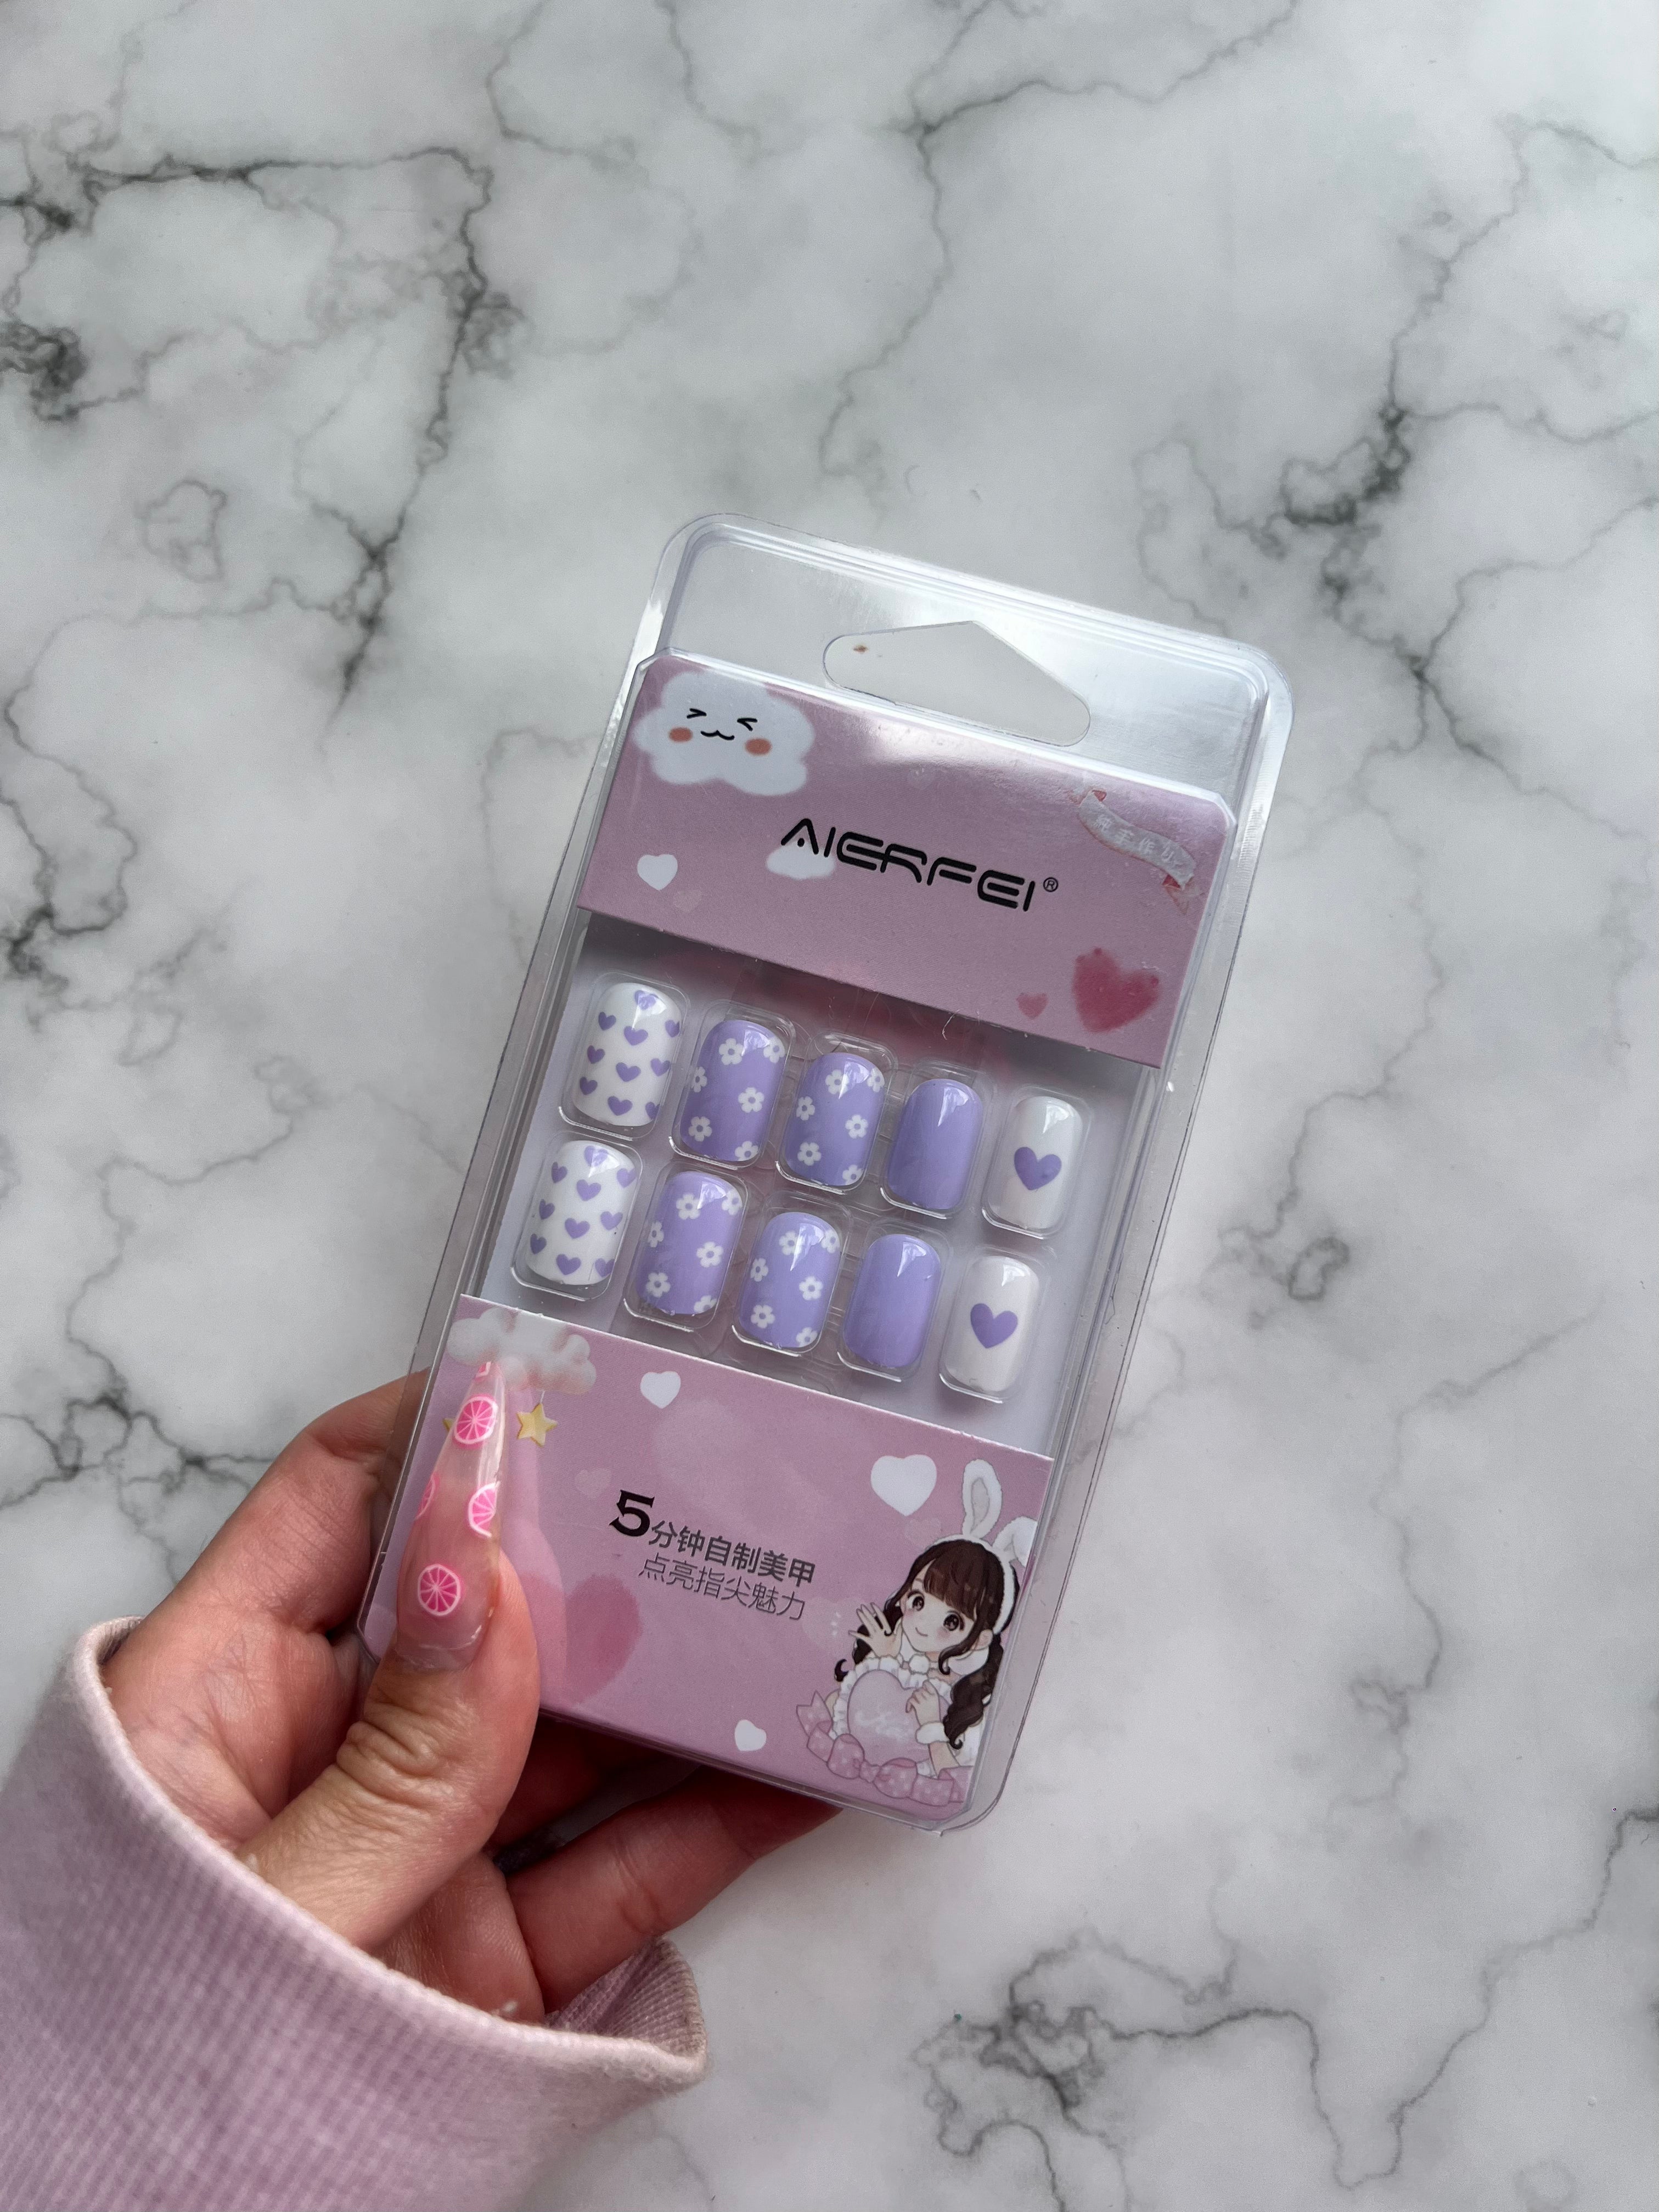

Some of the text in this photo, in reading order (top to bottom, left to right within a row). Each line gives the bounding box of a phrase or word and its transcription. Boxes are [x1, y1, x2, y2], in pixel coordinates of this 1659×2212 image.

[609, 1489, 816, 1588] 5分钟自制美甲
[638, 1552, 806, 1622] 点亮指尖魅力
